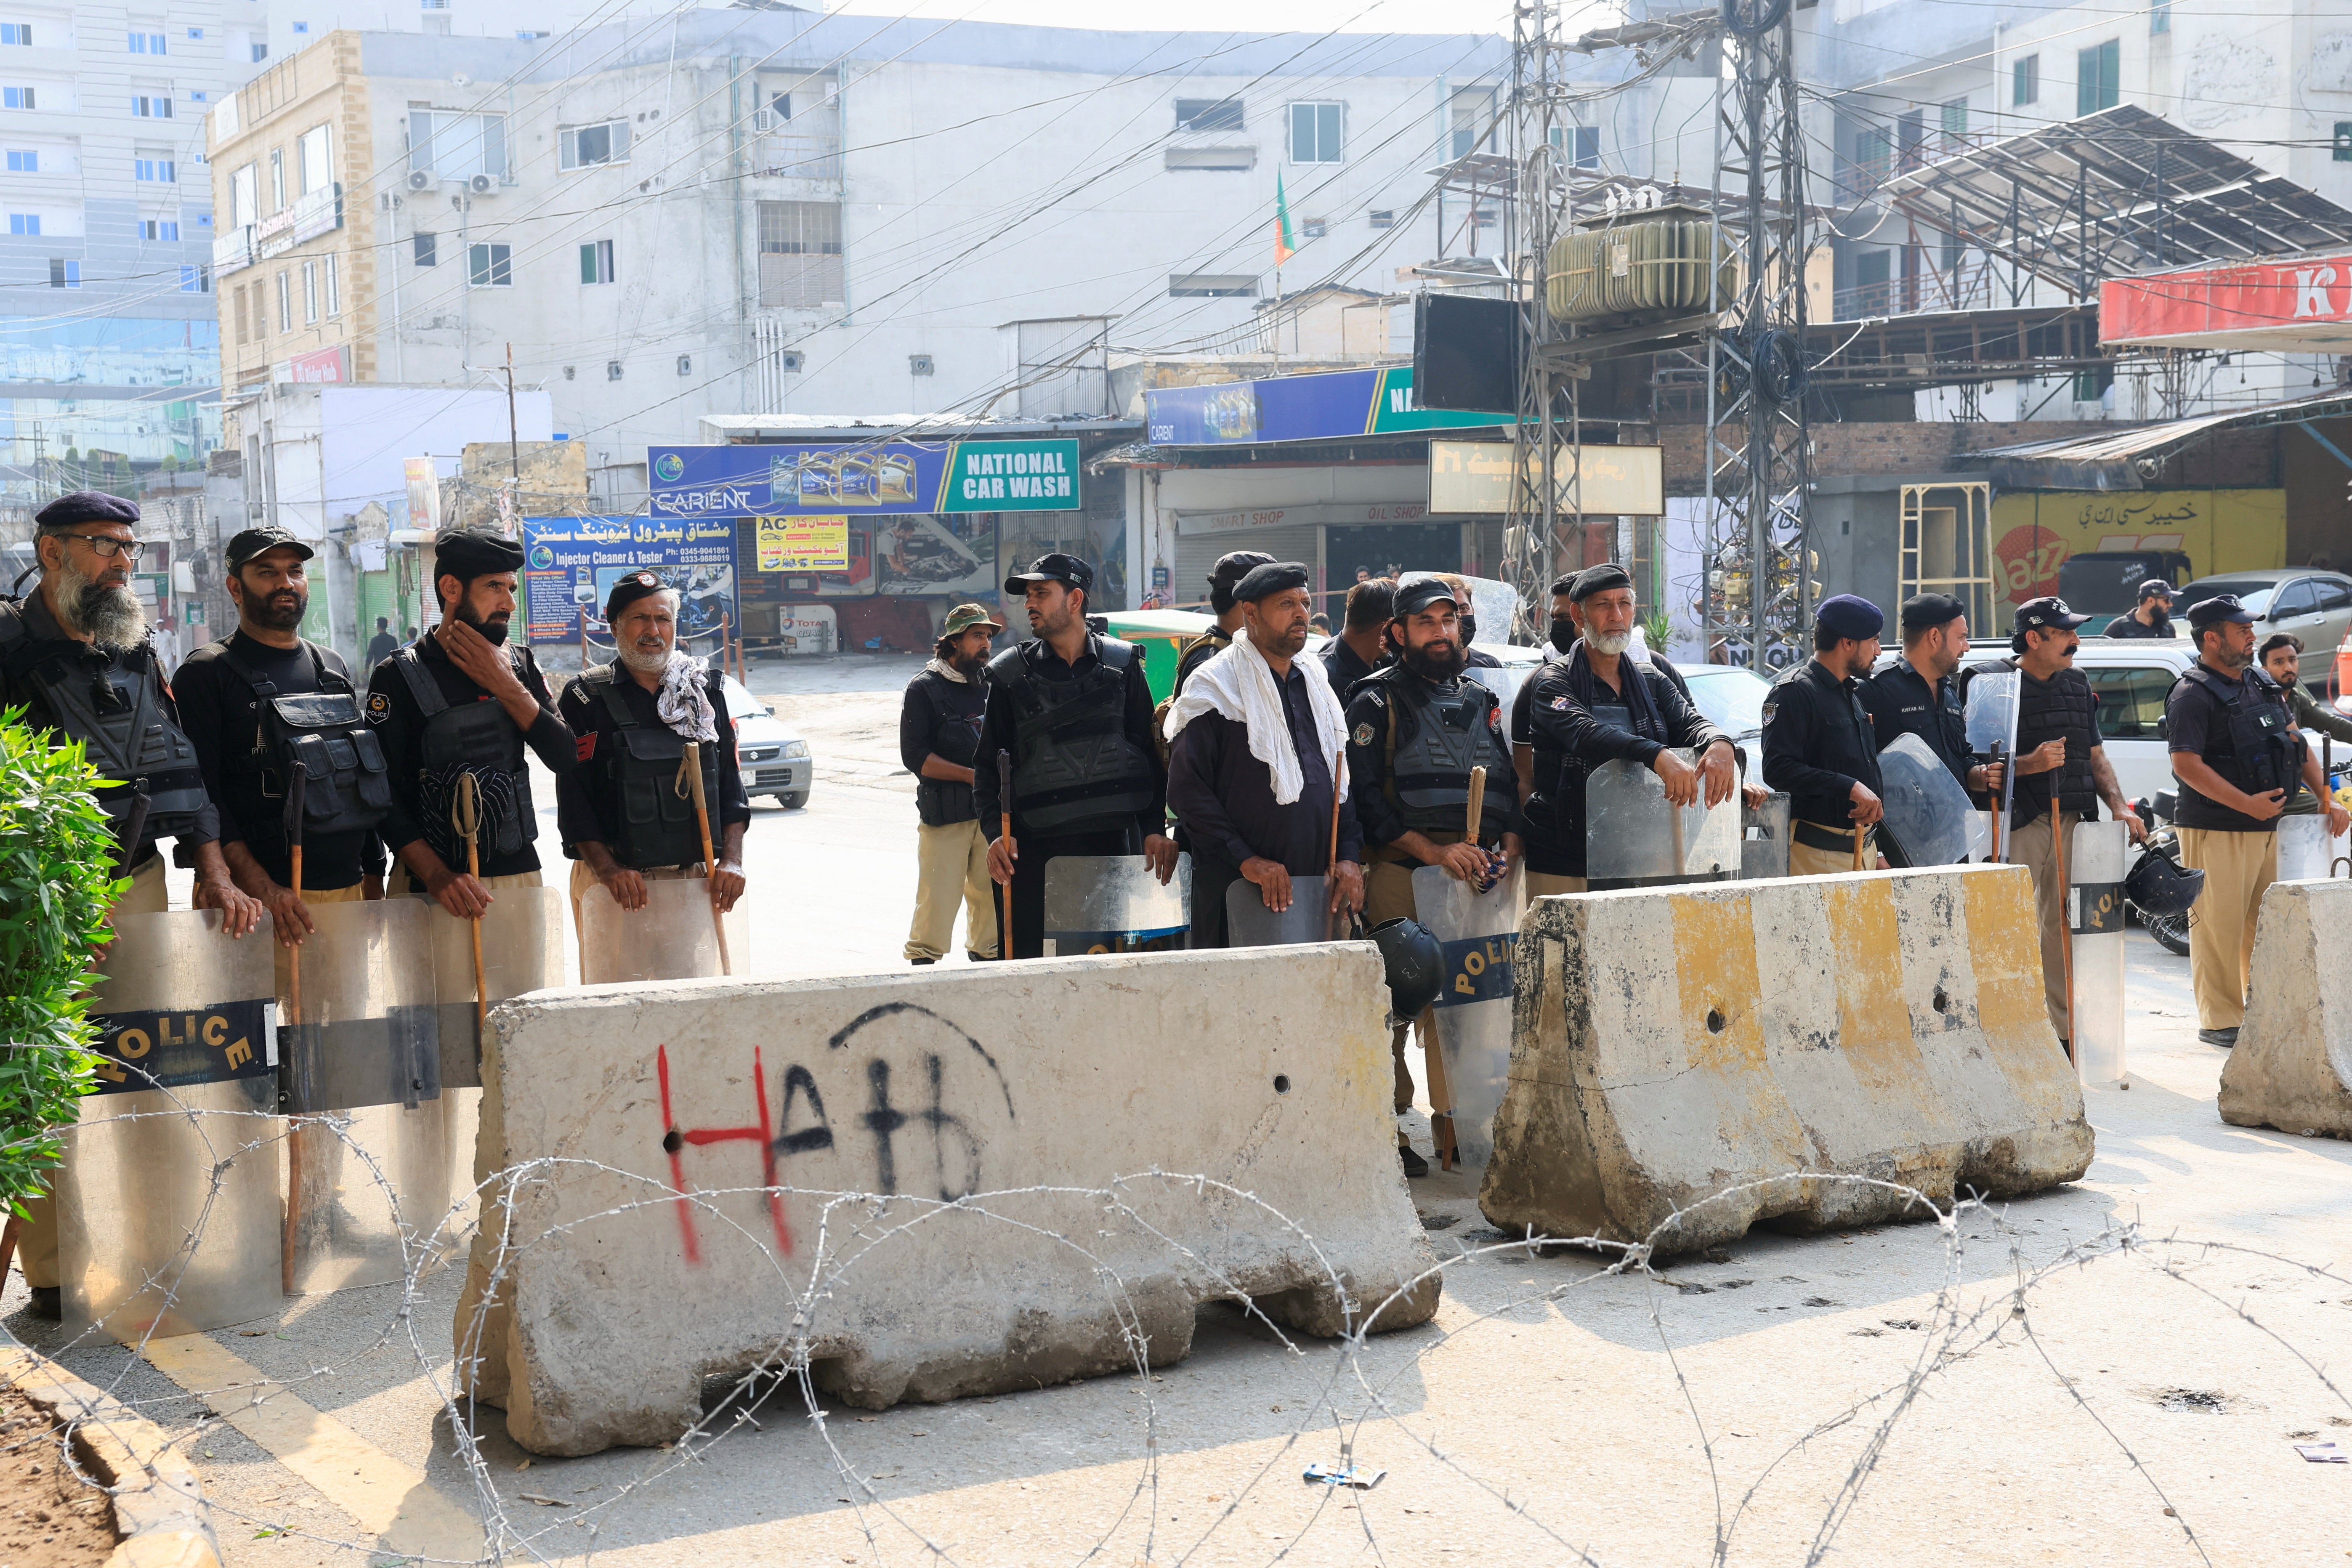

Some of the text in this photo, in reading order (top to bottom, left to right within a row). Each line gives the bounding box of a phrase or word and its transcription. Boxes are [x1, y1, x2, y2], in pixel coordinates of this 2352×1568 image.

[257, 206, 295, 240] Cosmetic
[1152, 425, 1174, 440] CARIENT
[967, 452, 1066, 475] NATIONAL
[963, 476, 1071, 500] CAR WASH
[657, 492, 751, 511] CARIENT
[791, 517, 807, 529] کار
[1210, 510, 1284, 529] SMART SHOP
[1368, 506, 1424, 520] OIL SHOP
[2145, 501, 2198, 525] خیبر
[255, 527, 290, 536] COMMANDO
[530, 524, 571, 545] سنٹر
[634, 522, 683, 545] پیٹرول
[686, 521, 731, 542] مشتاق
[760, 518, 787, 531] AC
[556, 551, 663, 568] Injector Cleaner & Tester
[680, 554, 730, 563] 0333-9888019
[1987, 538, 2070, 604] Jazz
[95, 1015, 252, 1083] POLICE
